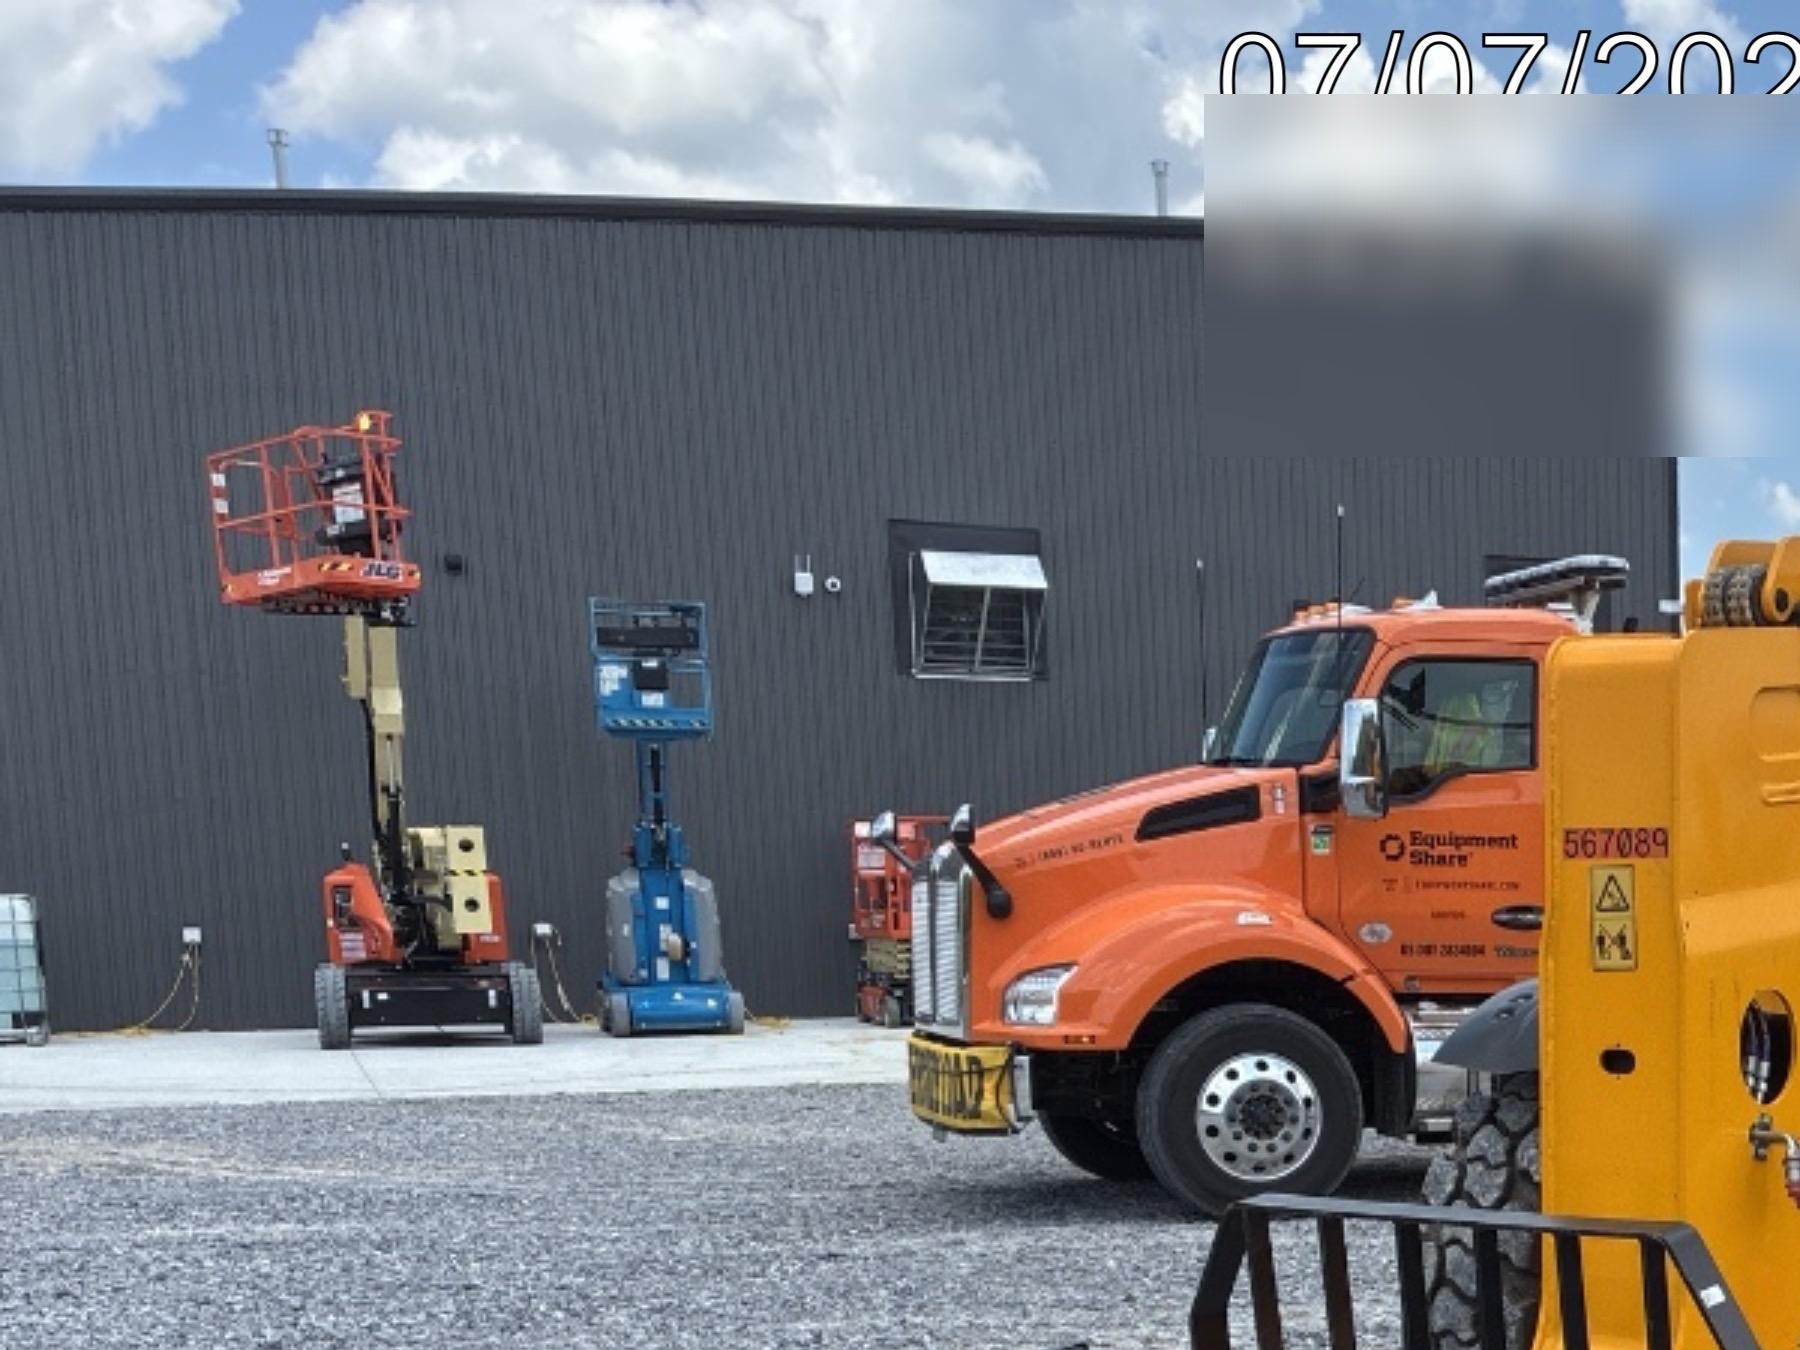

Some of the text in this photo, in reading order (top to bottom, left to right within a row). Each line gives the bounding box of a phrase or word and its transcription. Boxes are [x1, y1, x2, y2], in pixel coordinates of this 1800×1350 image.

[362, 562, 401, 580] JLG
[1409, 831, 1518, 850] Equipment
[1564, 828, 1669, 858] 567089
[1409, 850, 1468, 867] Share
